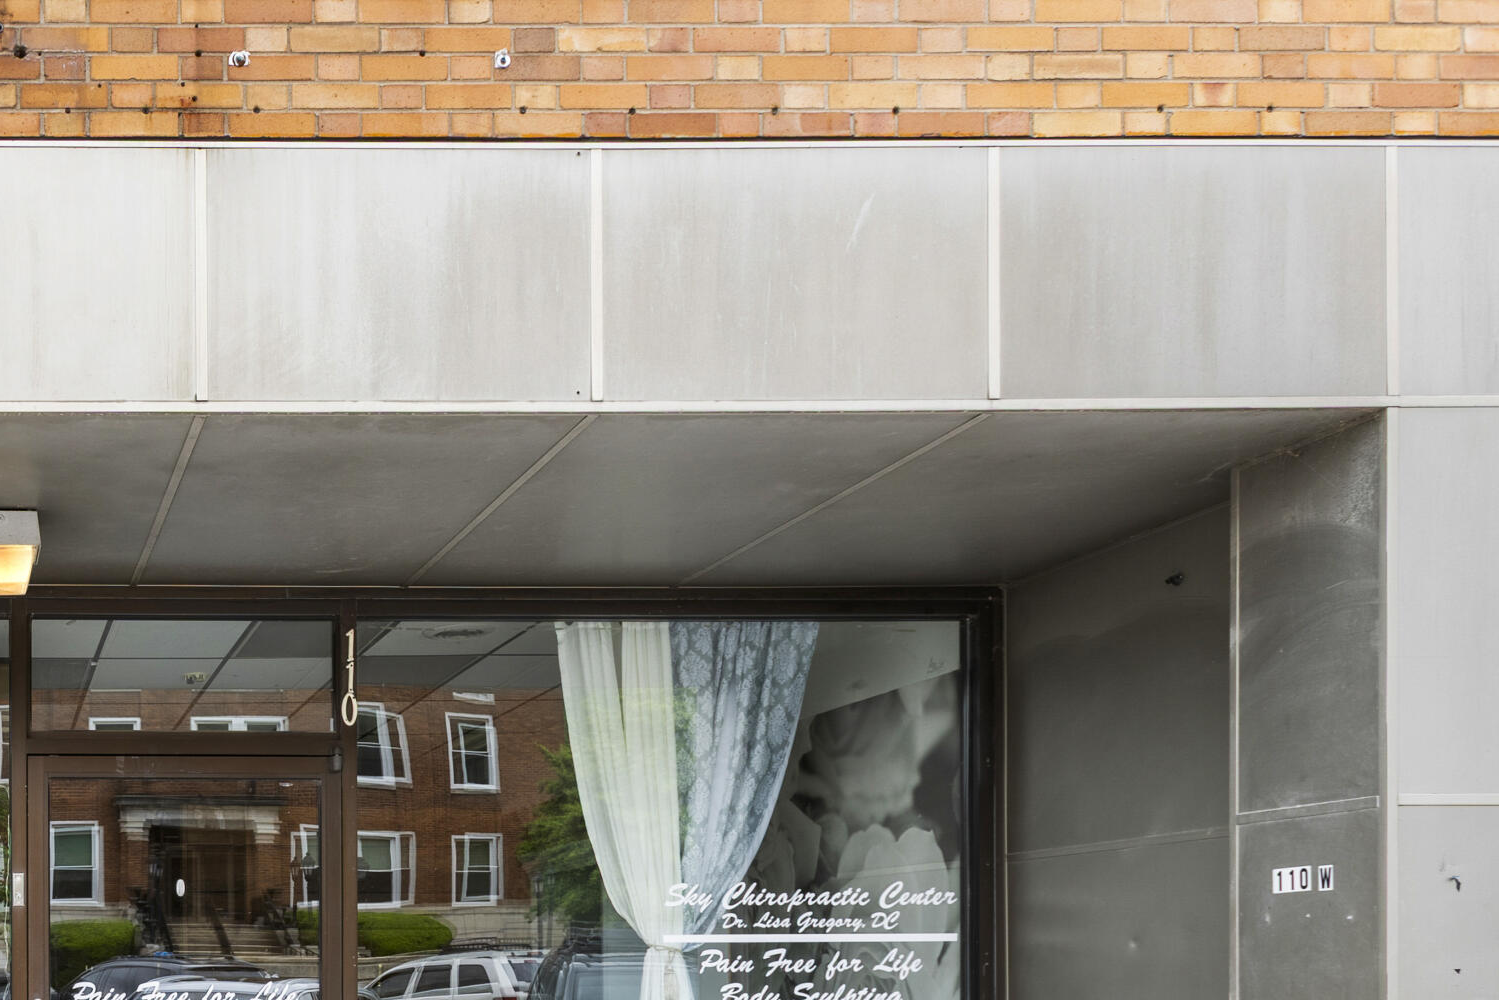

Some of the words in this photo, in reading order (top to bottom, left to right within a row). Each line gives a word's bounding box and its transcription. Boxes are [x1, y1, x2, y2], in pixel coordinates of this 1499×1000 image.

[341, 628, 358, 726] 110
[1277, 868, 1308, 891] 110
[1320, 867, 1331, 889] W
[664, 882, 713, 912] Sky
[722, 881, 871, 911] Chiropractic
[878, 881, 958, 908] Center
[721, 912, 748, 930] Dr.
[753, 912, 791, 929] Lisa
[870, 910, 901, 930] DC
[699, 949, 755, 974] Pain
[763, 948, 817, 975] Free
[825, 951, 864, 980] for
[873, 948, 924, 980] Life
